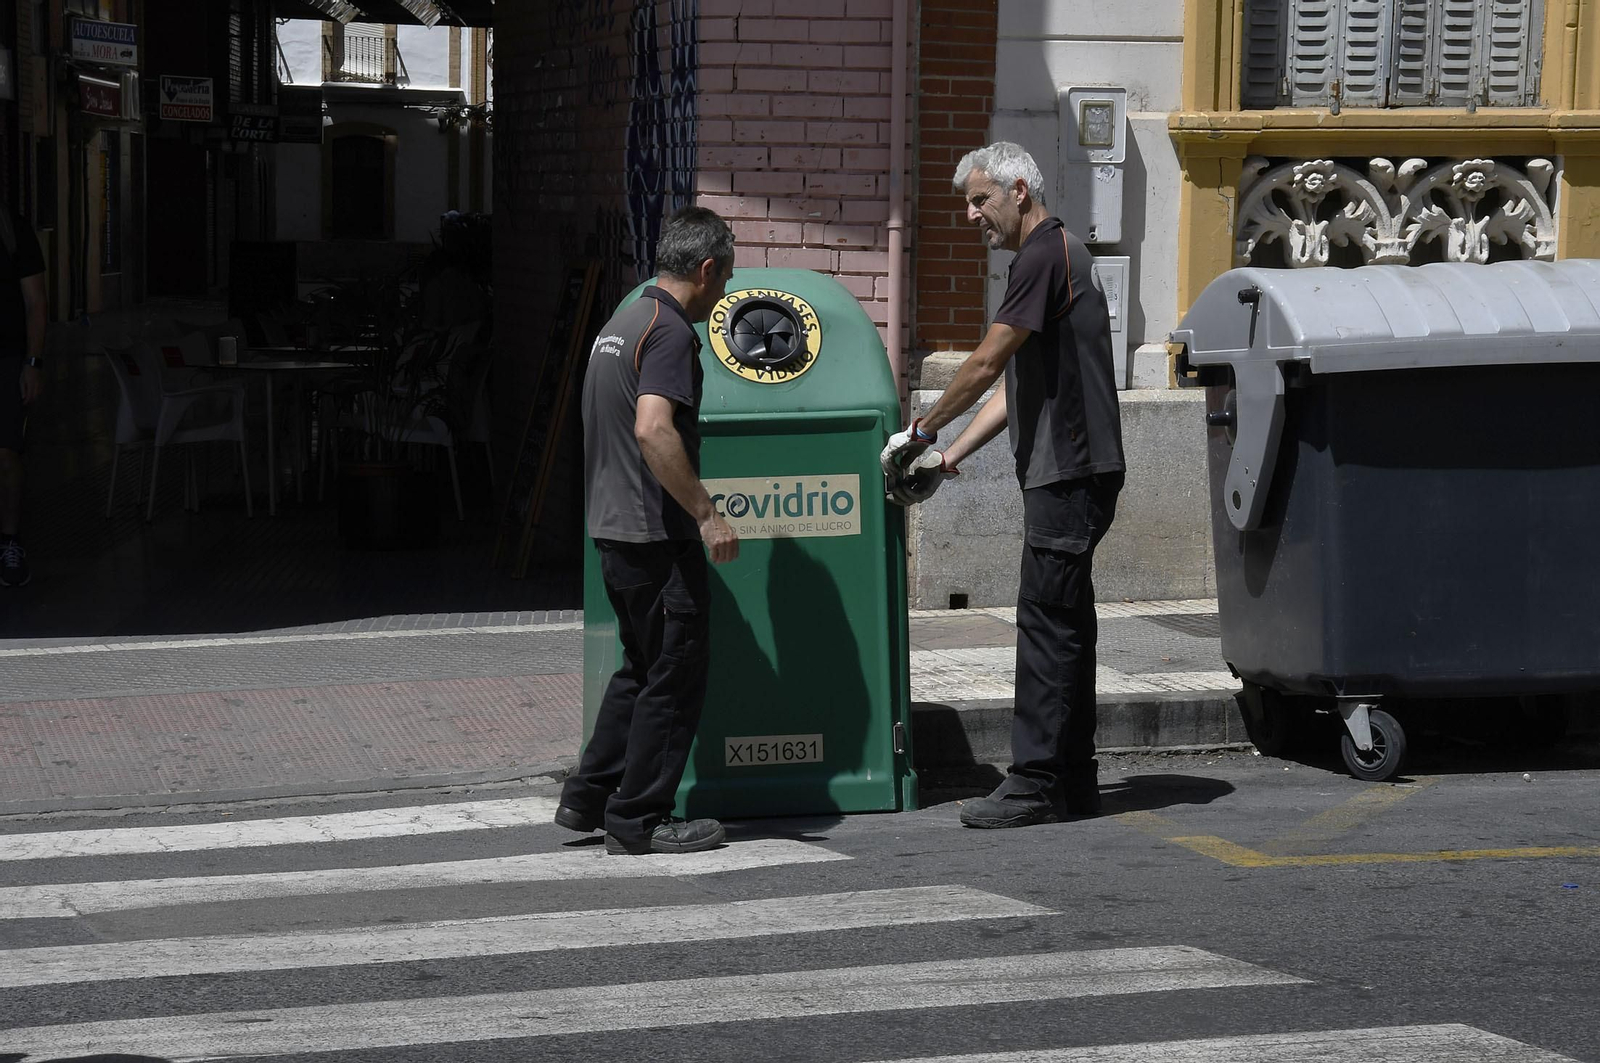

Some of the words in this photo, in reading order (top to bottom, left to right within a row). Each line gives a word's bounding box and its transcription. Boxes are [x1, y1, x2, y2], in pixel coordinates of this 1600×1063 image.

[74, 22, 135, 42] AUTOESCUELA
[92, 44, 118, 60] MORA
[162, 105, 210, 119] CONGELADOS
[232, 115, 252, 127] DE
[257, 117, 274, 129] LA
[231, 127, 274, 140] CORTE
[712, 295, 740, 334] SOLO
[746, 290, 817, 333] ENVASES
[725, 354, 746, 374] DE
[754, 350, 814, 381] VIDRIO
[710, 480, 854, 519] covidrio
[739, 525, 757, 535] SIN
[760, 523, 796, 534] ÁNIMO
[799, 522, 813, 532] DE
[816, 521, 852, 531] LUCRO
[729, 740, 817, 763] X151631
